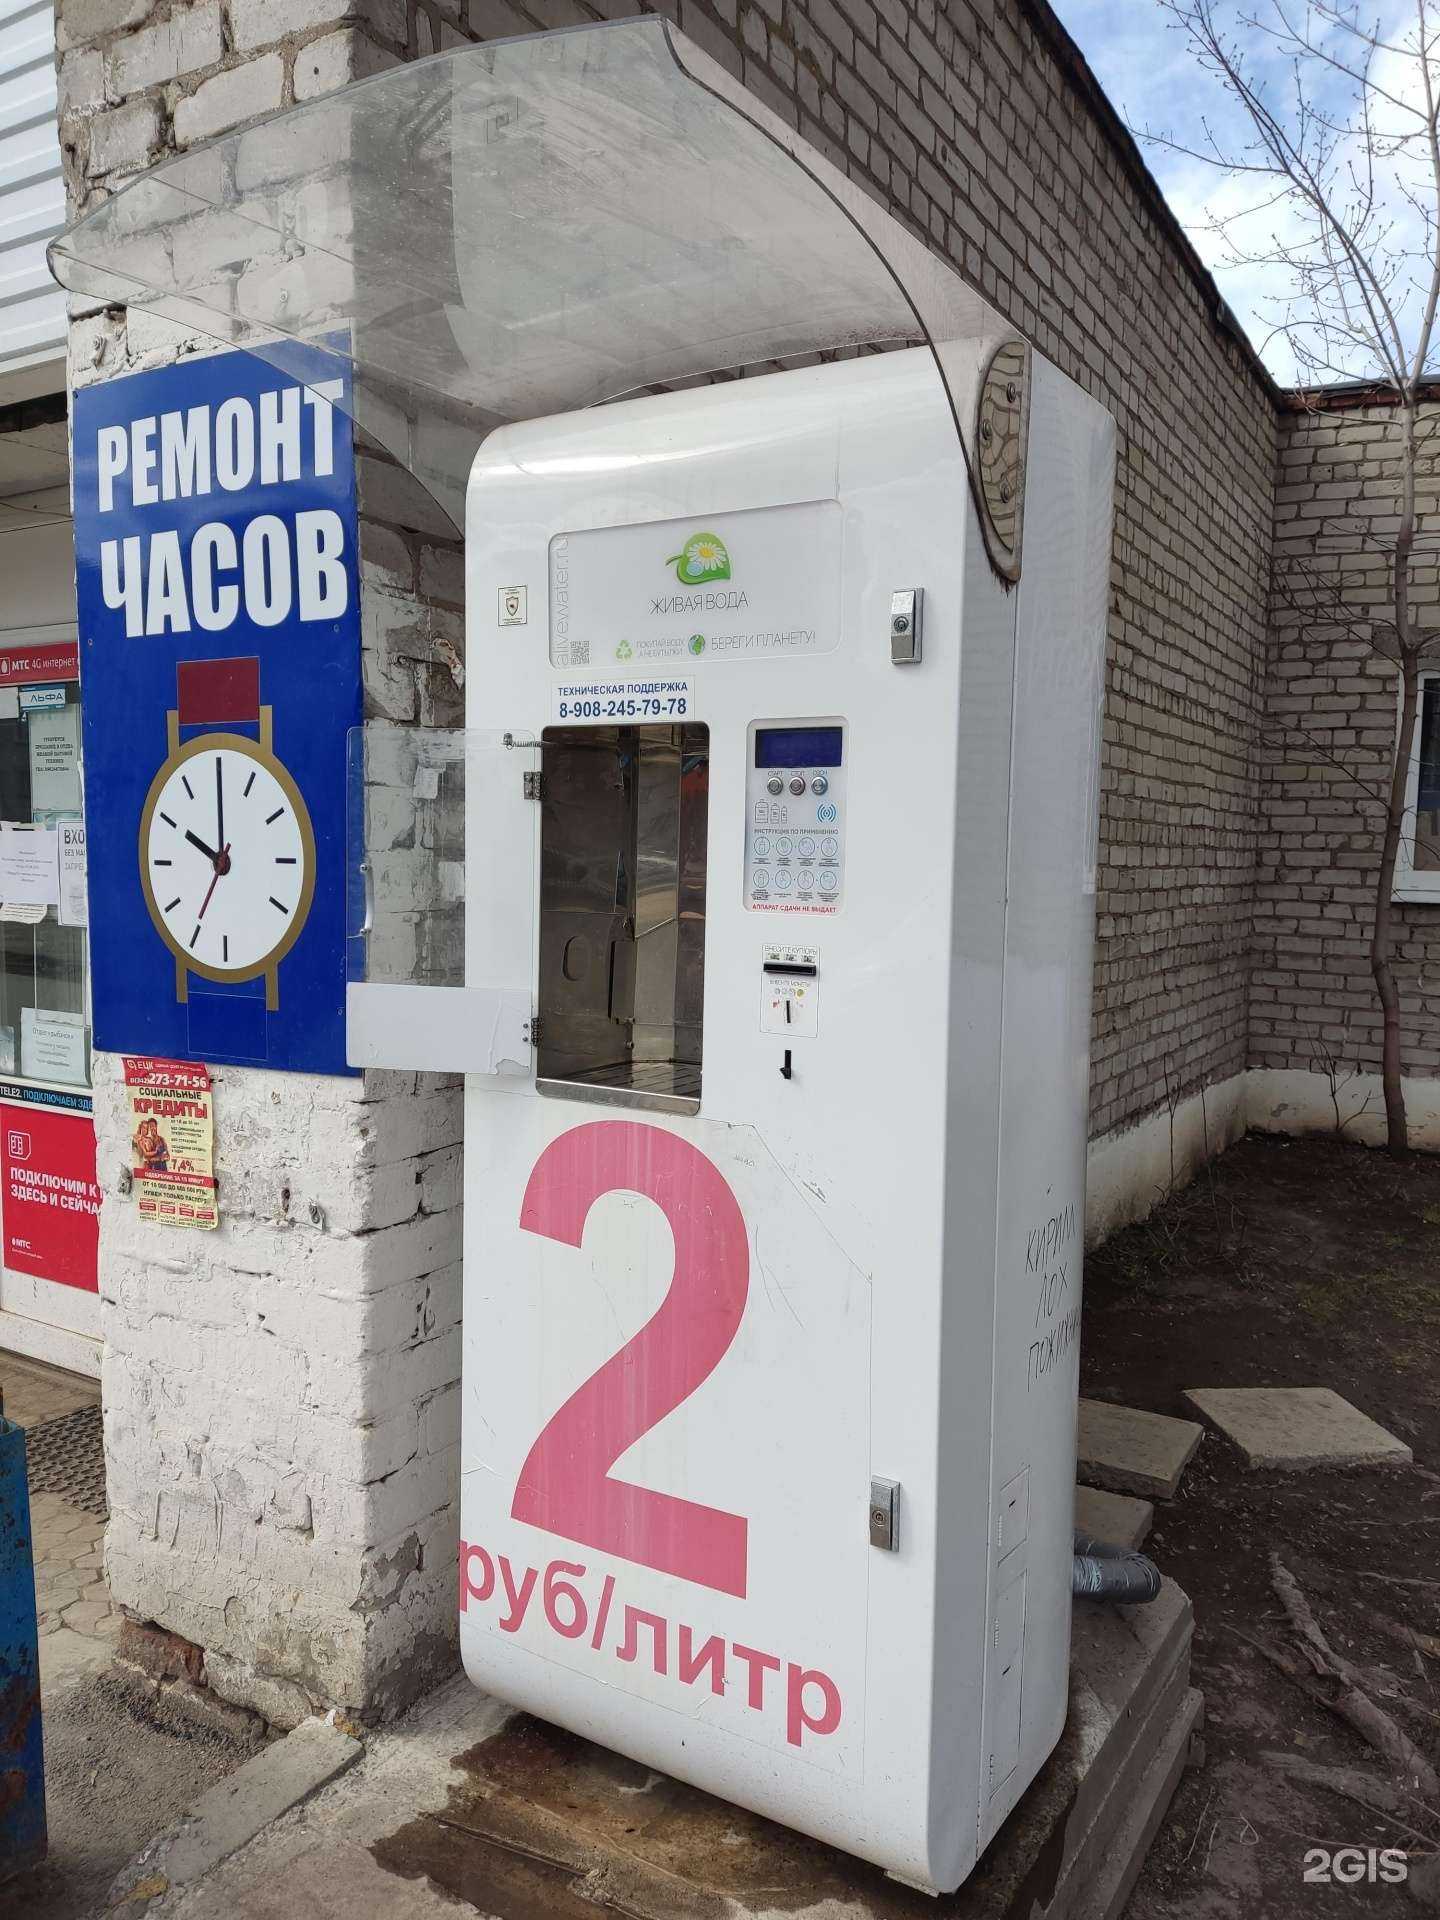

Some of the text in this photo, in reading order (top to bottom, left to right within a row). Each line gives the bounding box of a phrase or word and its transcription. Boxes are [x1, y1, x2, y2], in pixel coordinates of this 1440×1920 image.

[98, 378, 344, 512] РЕМОНТ
[101, 509, 348, 638] ЧАСОВ
[650, 591, 749, 615] ЖИВАЯ ВОДА
[711, 630, 816, 651] БЕРЕГИ ПЛАНЕТУ!
[12, 658, 76, 671] МТС 4G интернет
[558, 682, 688, 697] ТЕХНИЧЕСКАЯ ПОДДЕРЖКА
[559, 698, 688, 719] 8-908-245-79-78
[752, 903, 779, 911] АППАРАТ
[23, 1089, 77, 1108] ПОДКЛЮЧАЕМ
[139, 1087, 202, 1100] СОЦИАЛЬНЫЕ
[134, 1097, 208, 1119] КРЕДИТЫ
[10, 1166, 87, 1195] ПОДКЛЮЧИМ
[10, 1184, 48, 1204] ЗДЕСЬ
[49, 1192, 58, 1206] И
[1035, 1262, 1068, 1329] ЛОХ
[510, 1120, 750, 1600] 2
[458, 1539, 842, 1747] руб/литр
